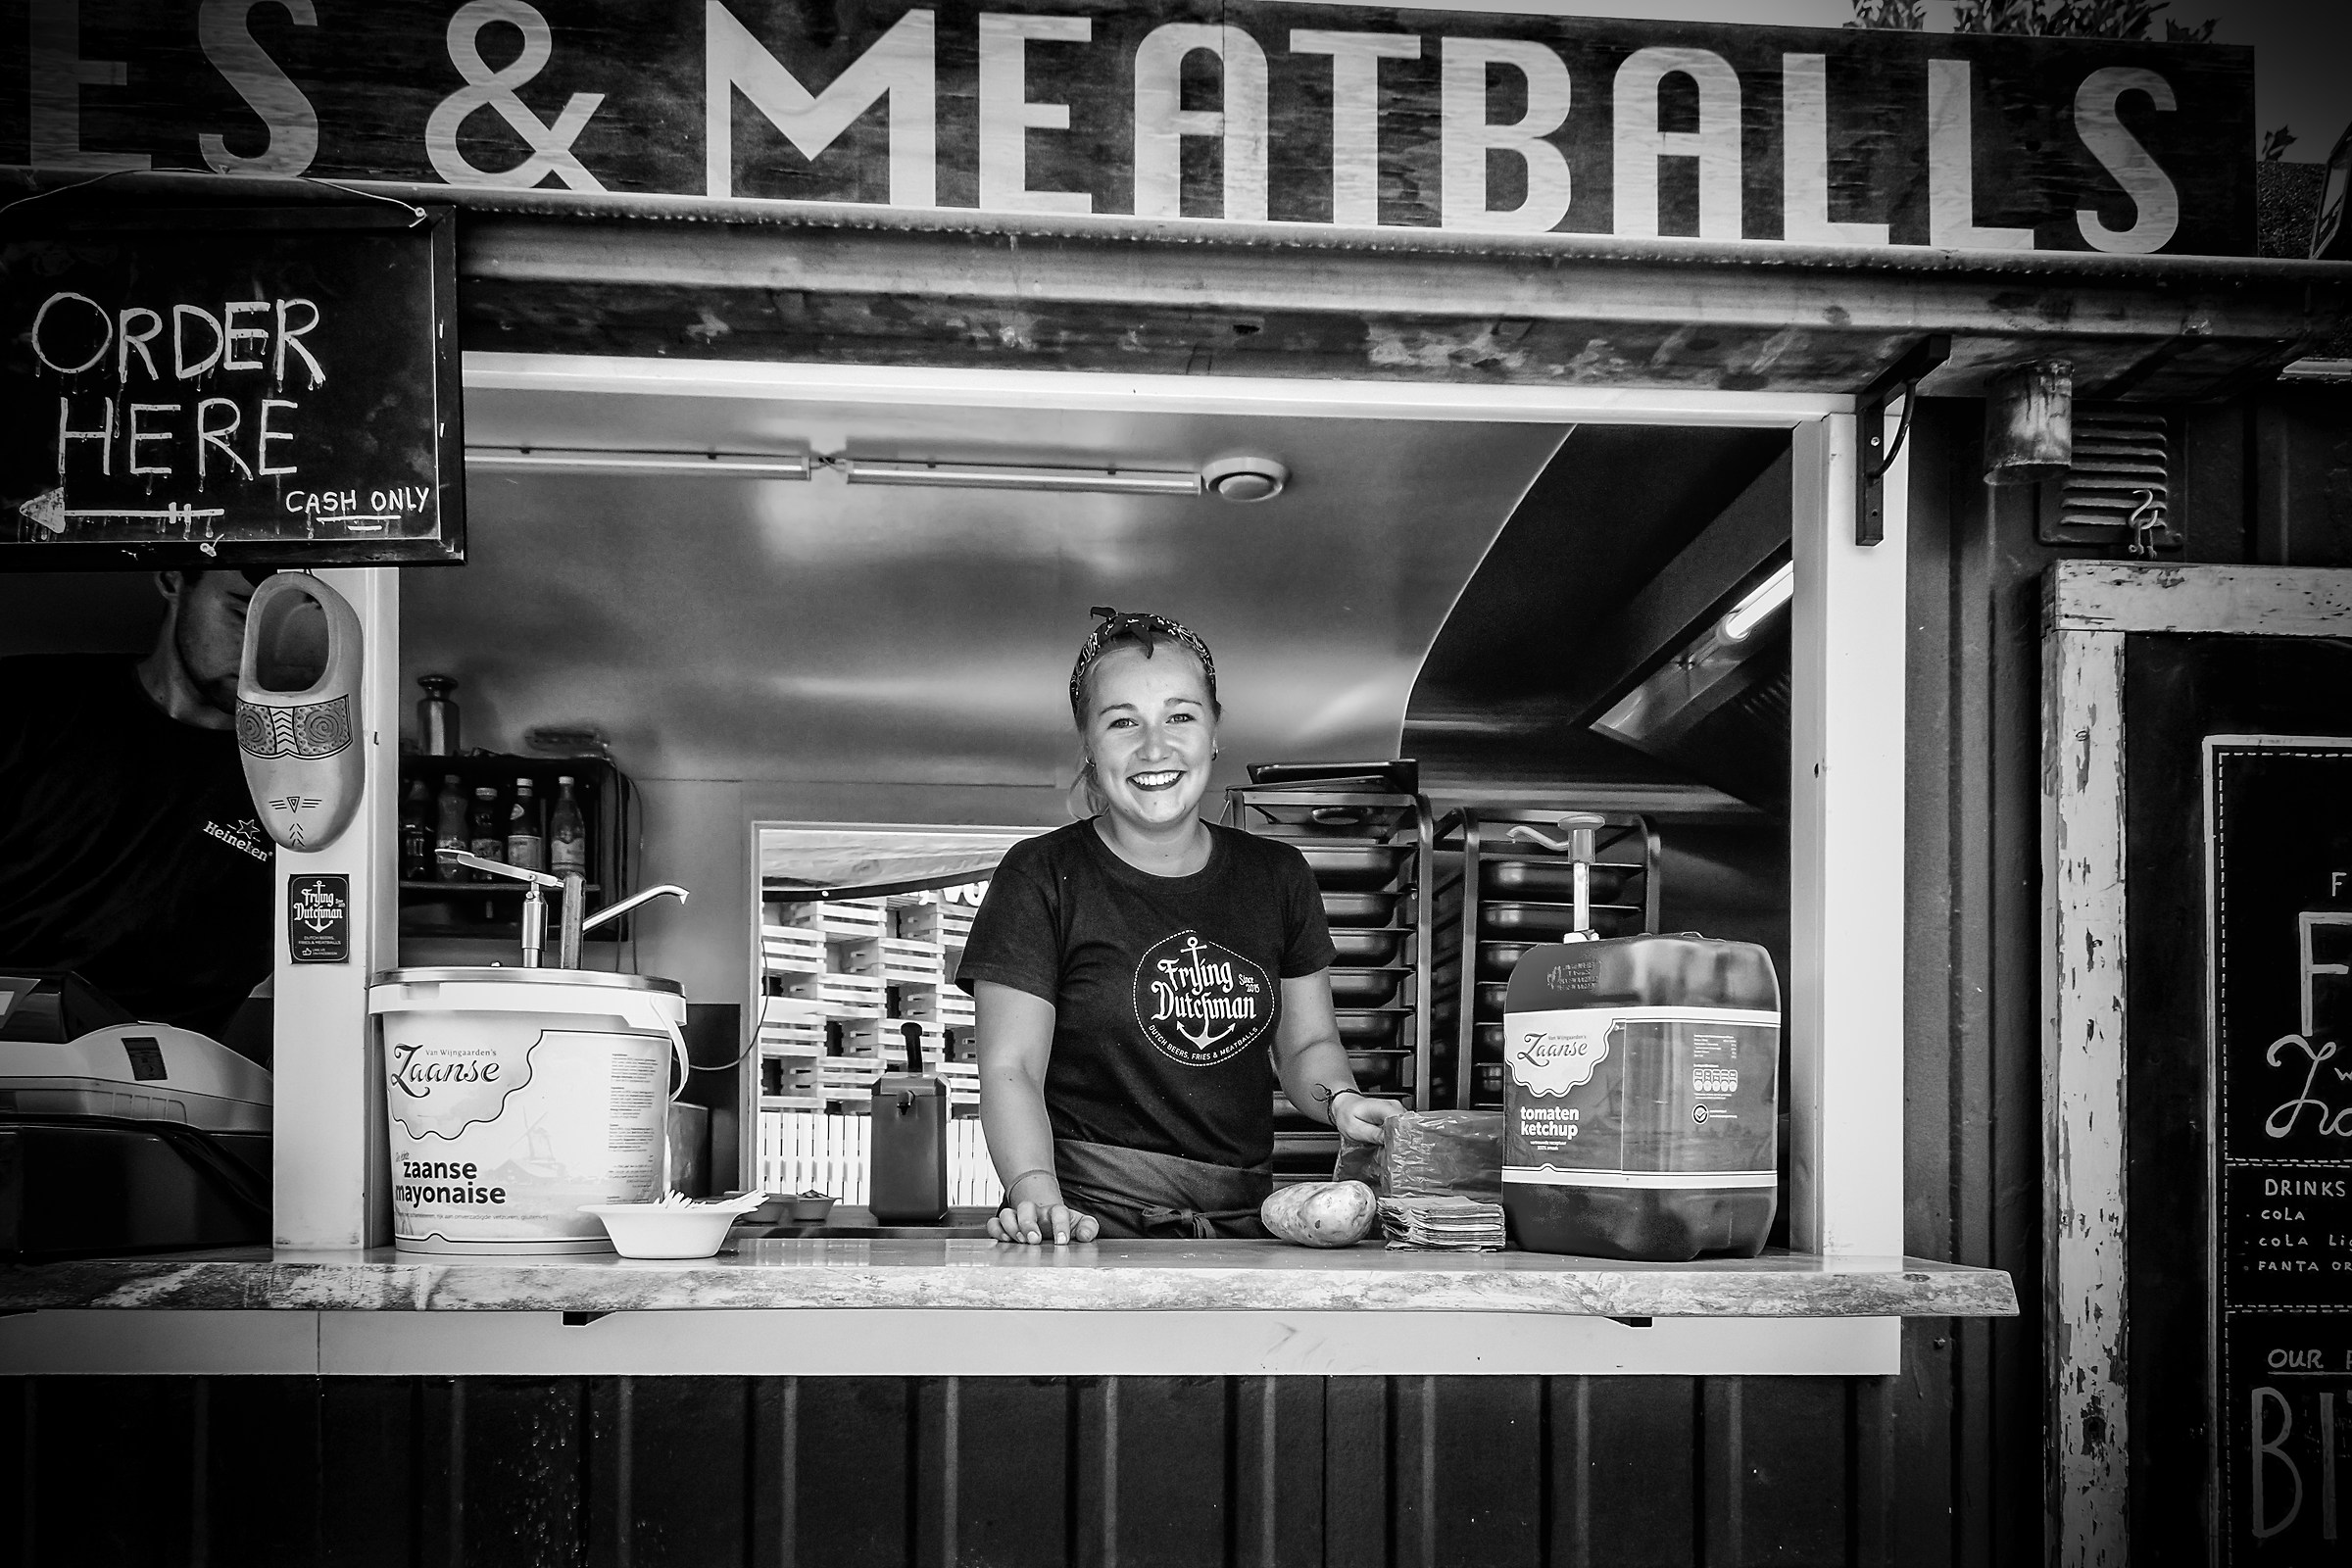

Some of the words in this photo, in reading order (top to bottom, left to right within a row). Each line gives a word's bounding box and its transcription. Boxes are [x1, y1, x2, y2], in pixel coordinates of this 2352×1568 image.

[425, 0, 606, 192] &
[706, 0, 2180, 254] MEATBALLS
[31, 292, 325, 390] ORDER
[59, 396, 298, 481] HERE
[285, 489, 357, 514] CASH
[370, 486, 429, 513] ONLY
[203, 820, 269, 862] Heineken
[293, 902, 344, 921] Dutchman
[301, 888, 334, 907] Frying
[1157, 957, 1234, 997] Frying
[1151, 980, 1257, 1021] Dutchman
[1148, 1024, 1168, 1047] DUTCH
[1219, 1026, 1258, 1056] MEATBALLS
[1516, 1032, 1588, 1068] Zaanse
[391, 1043, 501, 1099] Zaanse
[1520, 1105, 1580, 1121] tomaten
[1520, 1120, 1579, 1141] ketchup
[403, 1160, 478, 1180] zaanse
[394, 1181, 507, 1208] mayonaise
[2265, 1178, 2346, 1197] DRINKS
[2258, 1260, 2320, 1272] FANTA
[2267, 1348, 2325, 1369] OUR
[2251, 1386, 2352, 1541] BI
